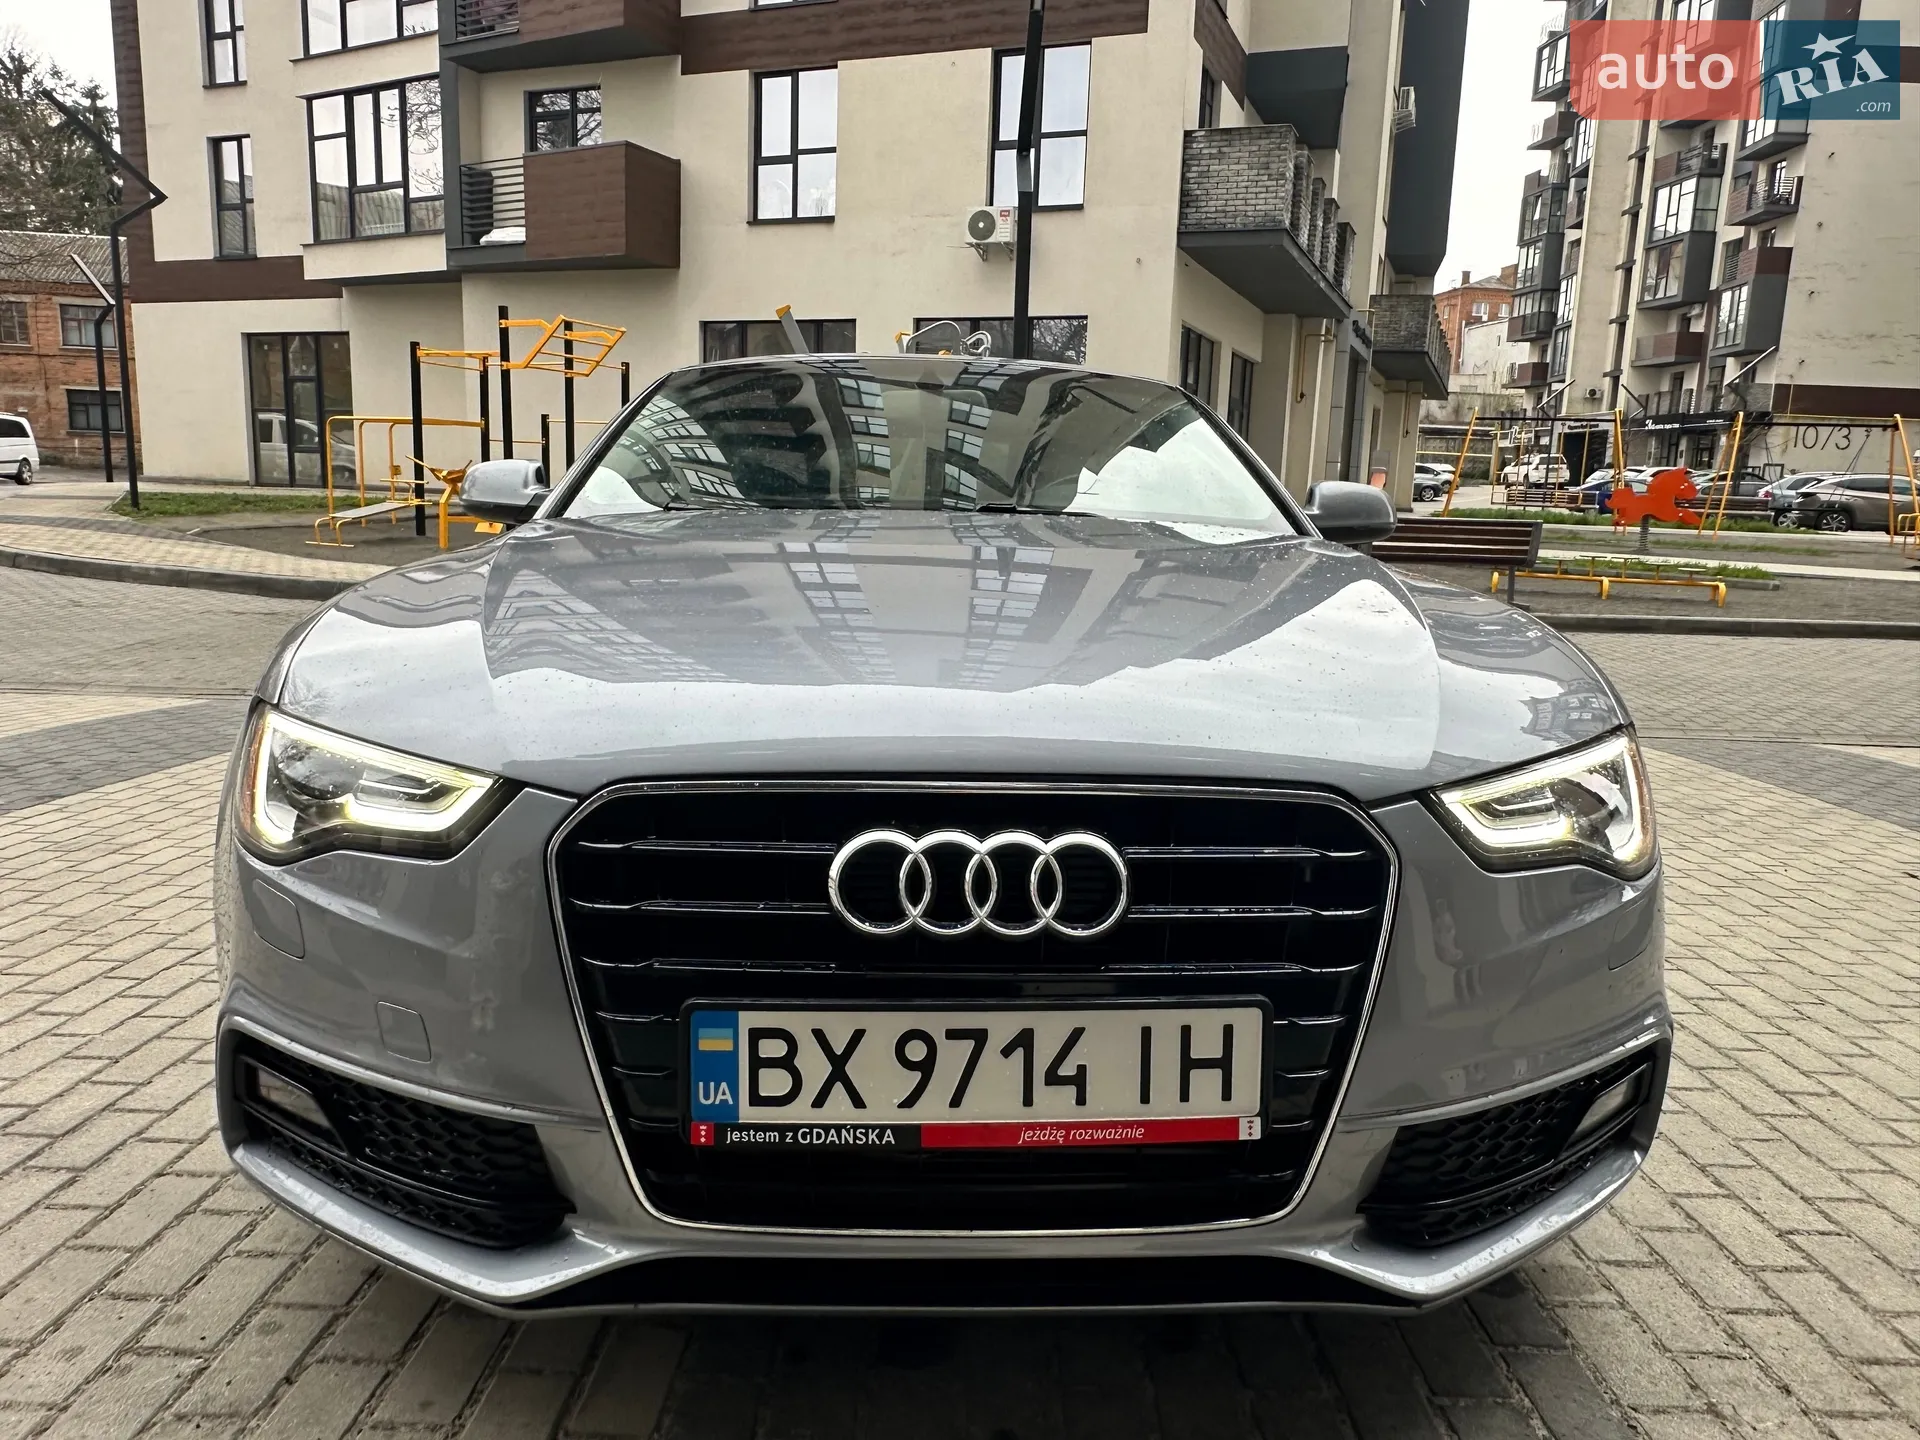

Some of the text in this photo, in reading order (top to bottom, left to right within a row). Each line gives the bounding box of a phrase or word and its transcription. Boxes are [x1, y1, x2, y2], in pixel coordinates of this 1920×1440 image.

[1793, 425, 1851, 450] 10/3
[748, 1024, 1234, 1109] BX 9714 IH
[698, 1081, 733, 1105] UA
[726, 1125, 896, 1145] jestem z GDAŃSKA
[1018, 1124, 1145, 1145] jeżdżę rozważnie
